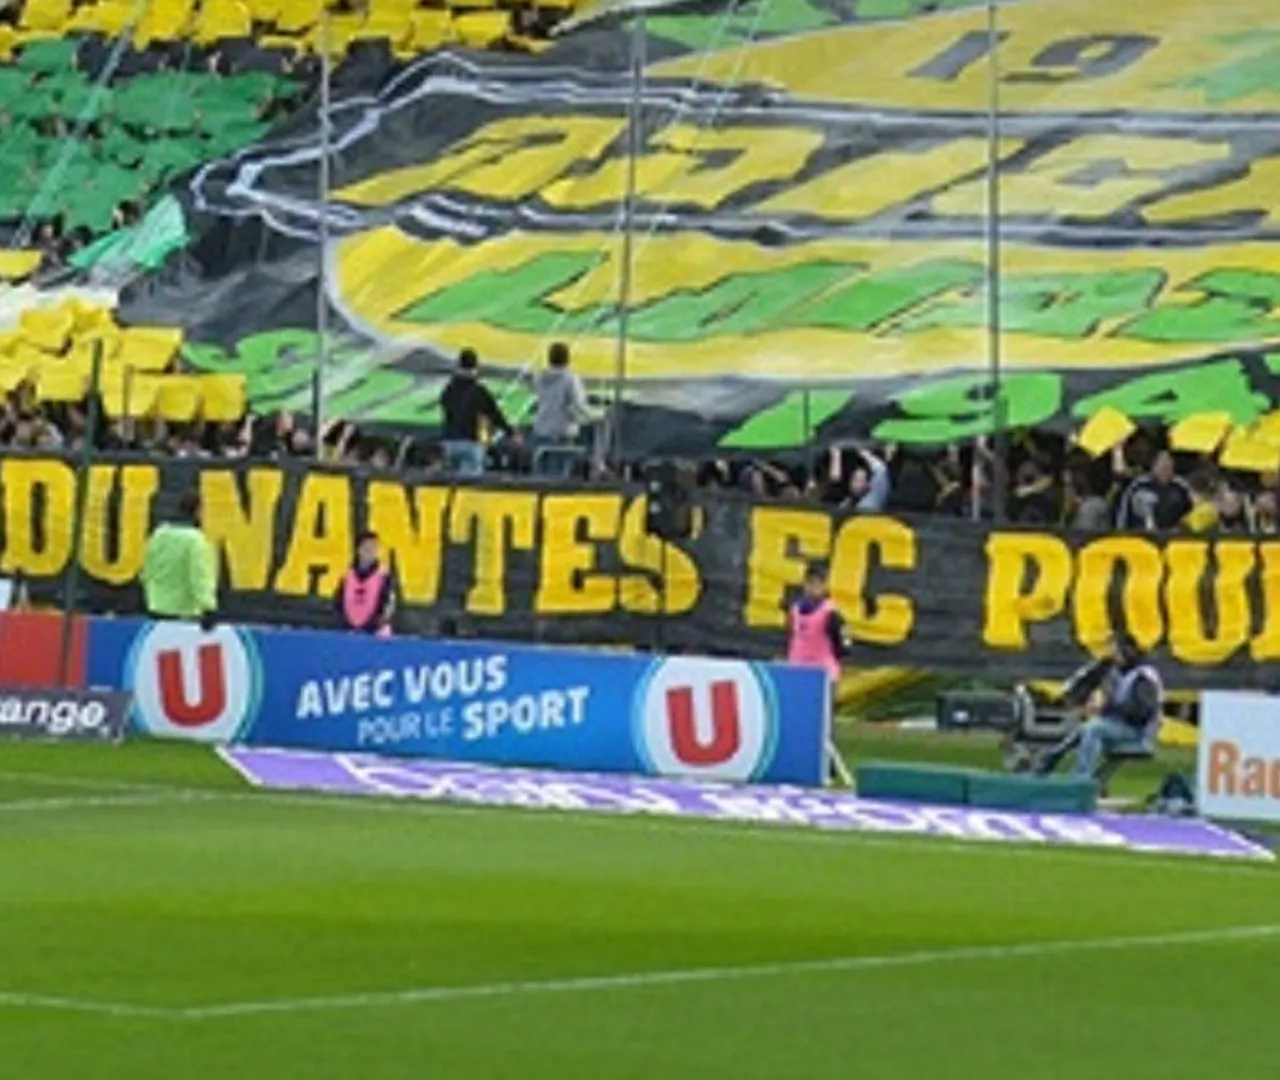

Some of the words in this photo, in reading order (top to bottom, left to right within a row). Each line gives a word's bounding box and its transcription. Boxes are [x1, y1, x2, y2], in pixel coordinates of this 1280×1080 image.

[0, 457, 160, 584] DU
[200, 466, 704, 615] NANTES
[744, 506, 916, 645] FC
[156, 643, 229, 727] U
[296, 669, 394, 718] AVEC
[403, 654, 508, 703] VOUS
[356, 711, 421, 745] POUR
[423, 705, 455, 737] LE
[462, 685, 591, 741] SPORT
[666, 679, 741, 766] U
